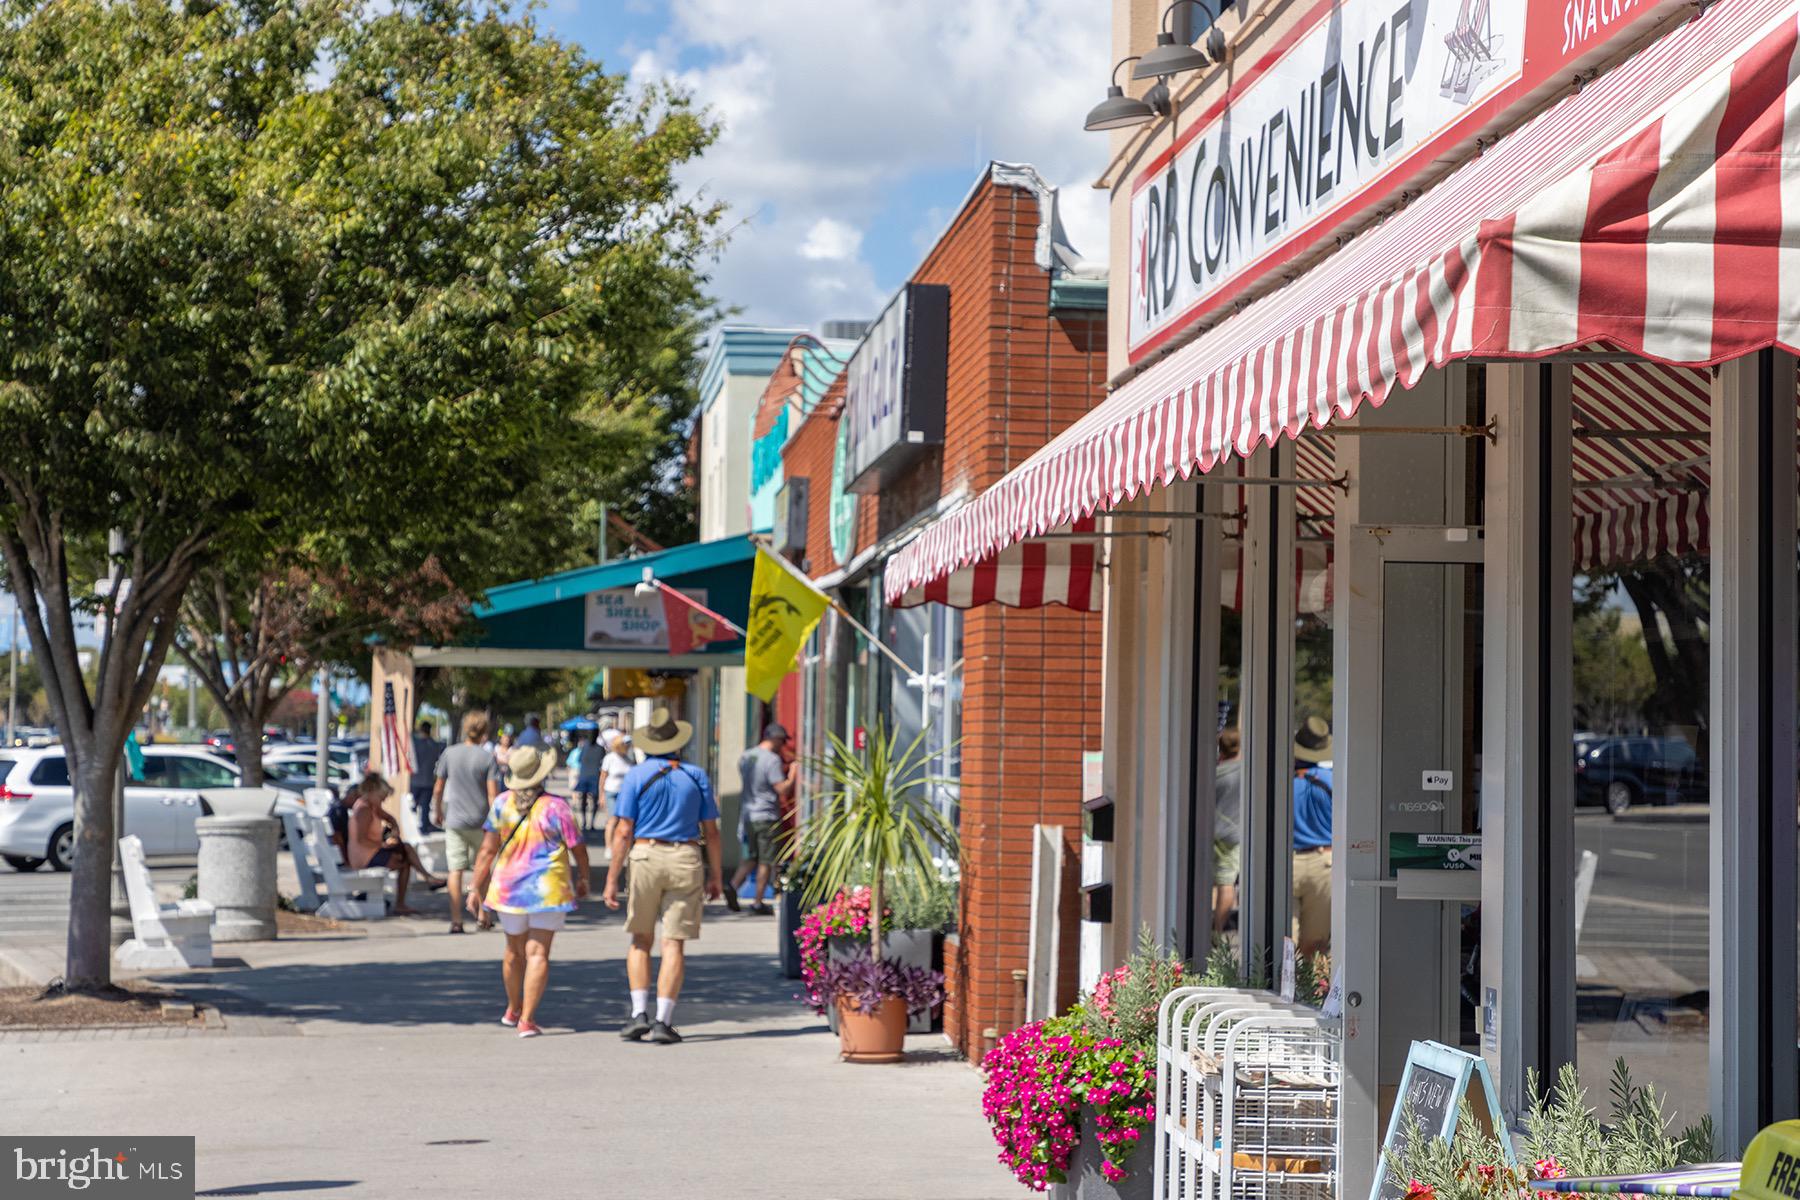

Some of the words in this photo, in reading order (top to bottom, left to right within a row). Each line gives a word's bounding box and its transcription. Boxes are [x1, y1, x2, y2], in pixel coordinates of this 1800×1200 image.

[1147, 168, 1179, 322] RB
[596, 594, 624, 605] SEA
[606, 606, 651, 618] SHELL
[621, 620, 660, 631] SHOP
